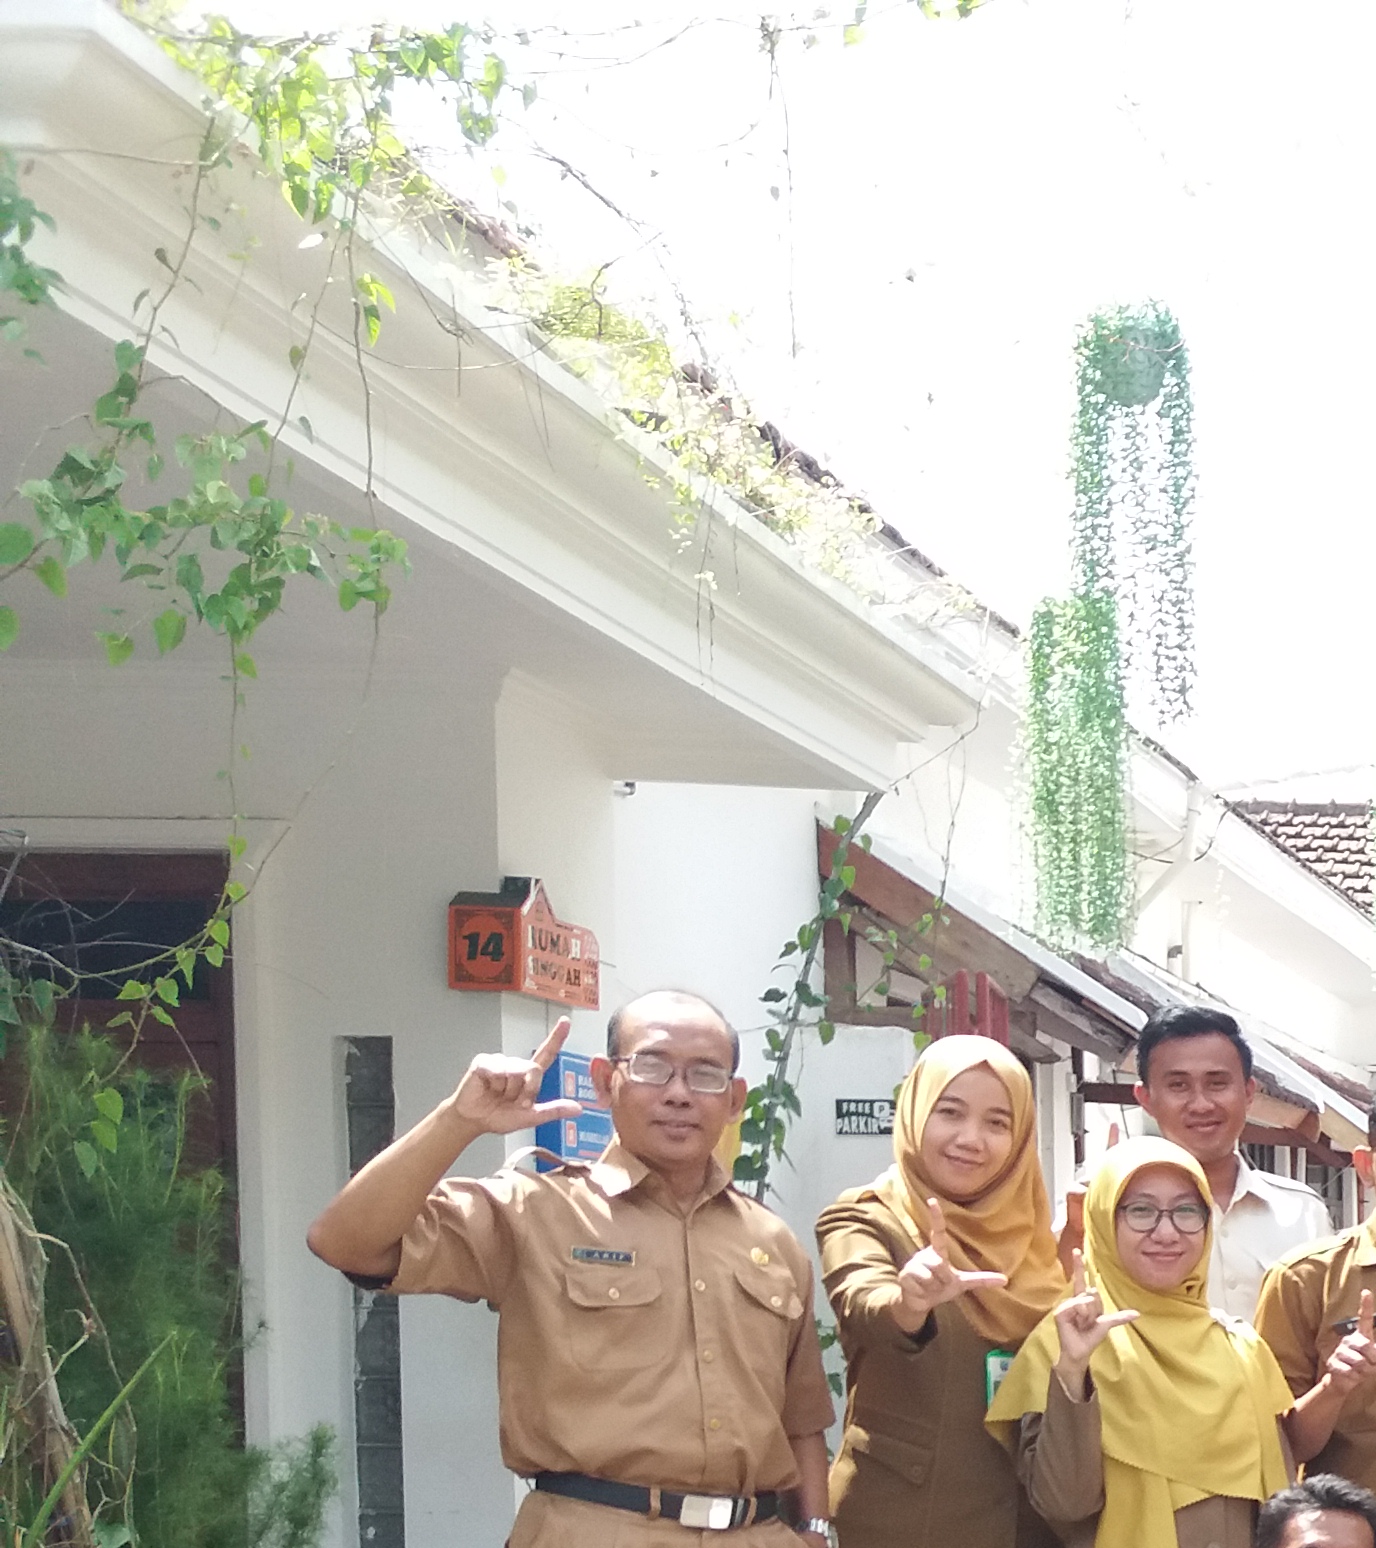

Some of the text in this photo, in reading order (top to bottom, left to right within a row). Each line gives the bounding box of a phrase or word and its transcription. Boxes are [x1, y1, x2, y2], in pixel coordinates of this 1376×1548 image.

[462, 932, 505, 962] 14
[527, 925, 581, 961] RUMAH
[842, 1101, 871, 1114] FREE
[836, 1116, 880, 1134] PARKIR
